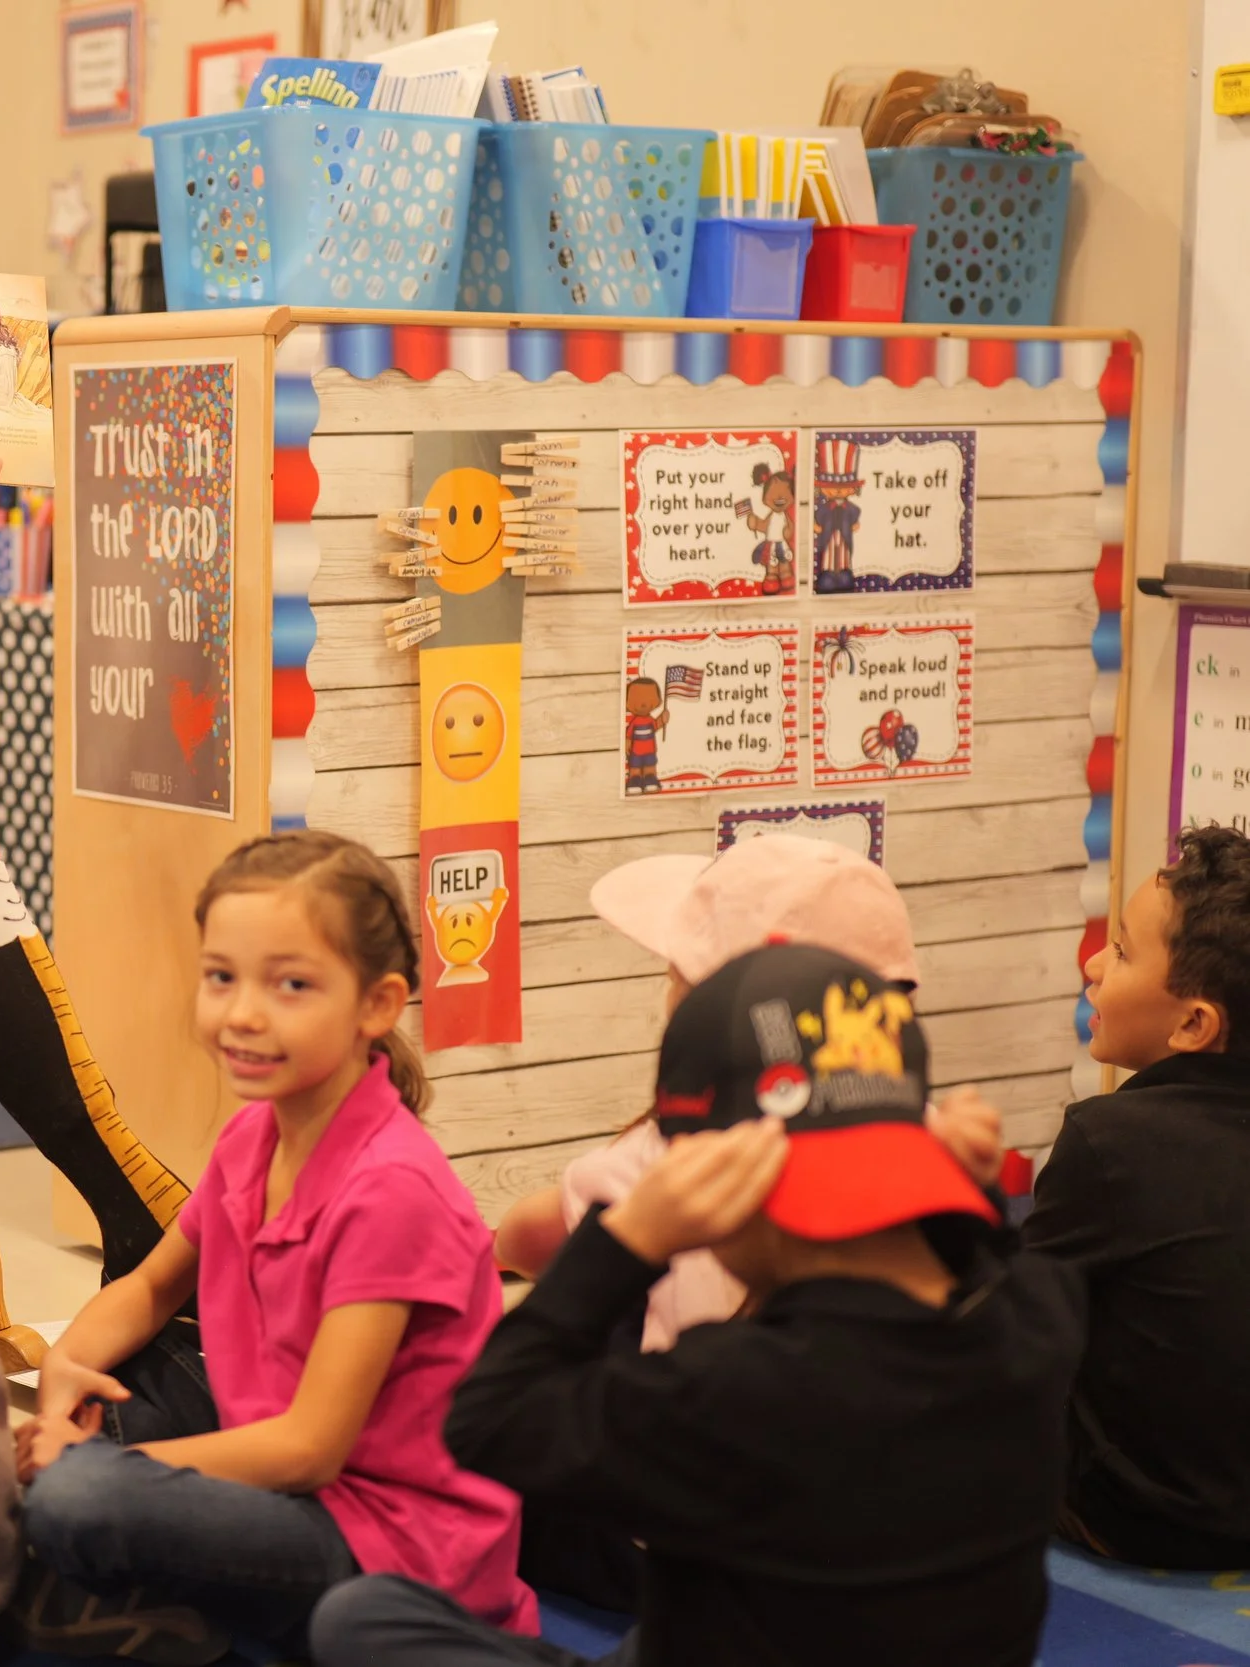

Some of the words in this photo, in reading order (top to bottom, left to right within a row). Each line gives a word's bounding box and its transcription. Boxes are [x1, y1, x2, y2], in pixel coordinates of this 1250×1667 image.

[89, 422, 169, 478] Trust
[184, 423, 213, 478] in
[656, 470, 683, 485] Put
[688, 471, 726, 488] your
[873, 470, 918, 489] Take
[924, 469, 948, 488] off
[649, 495, 688, 515] right
[695, 492, 733, 510] hand
[891, 504, 931, 524] your
[90, 503, 134, 559] the
[148, 505, 218, 562] LORD
[652, 523, 689, 537] over
[695, 522, 731, 539] your
[894, 530, 927, 548] hat.
[669, 545, 716, 561] heart.
[90, 585, 152, 642] with
[167, 587, 199, 644] all
[705, 660, 749, 677] Stand
[753, 662, 772, 678] up
[859, 656, 906, 680] Speak
[912, 655, 948, 673] loud
[1196, 653, 1219, 677] ck
[1229, 665, 1240, 678] in
[90, 665, 154, 721] your
[709, 684, 769, 704] straight
[859, 684, 888, 702] and
[894, 681, 946, 705] proud!
[706, 710, 735, 728] and
[740, 708, 772, 725] face
[1194, 710, 1203, 727] e
[1213, 717, 1224, 729] in
[706, 735, 733, 752] the
[738, 733, 772, 753] flag.
[1191, 763, 1202, 779] o
[1212, 769, 1223, 782] in
[440, 867, 488, 894] HELP
